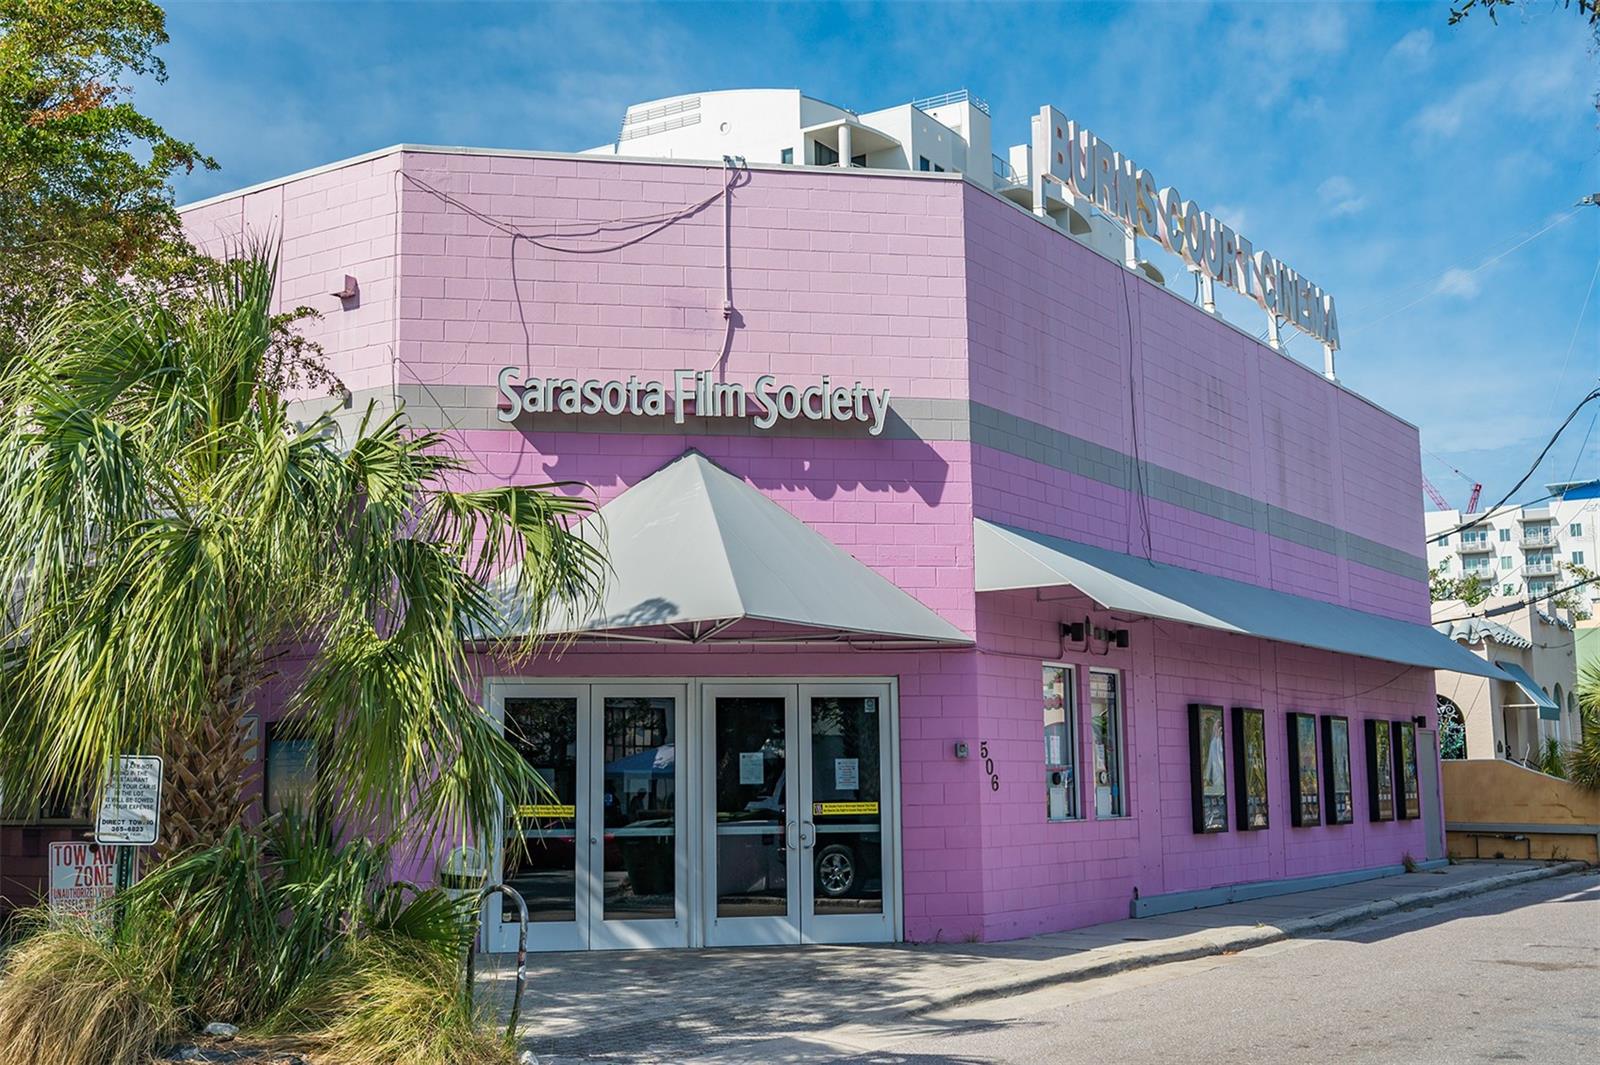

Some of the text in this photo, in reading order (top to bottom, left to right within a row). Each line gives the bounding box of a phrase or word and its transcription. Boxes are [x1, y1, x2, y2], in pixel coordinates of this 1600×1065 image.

[1040, 104, 1341, 351] BURNS COURT CINEMA
[497, 366, 891, 436] Sarasota Film Society
[980, 741, 999, 792] 506
[54, 845, 87, 866] TOW
[74, 865, 113, 887] ZONE
